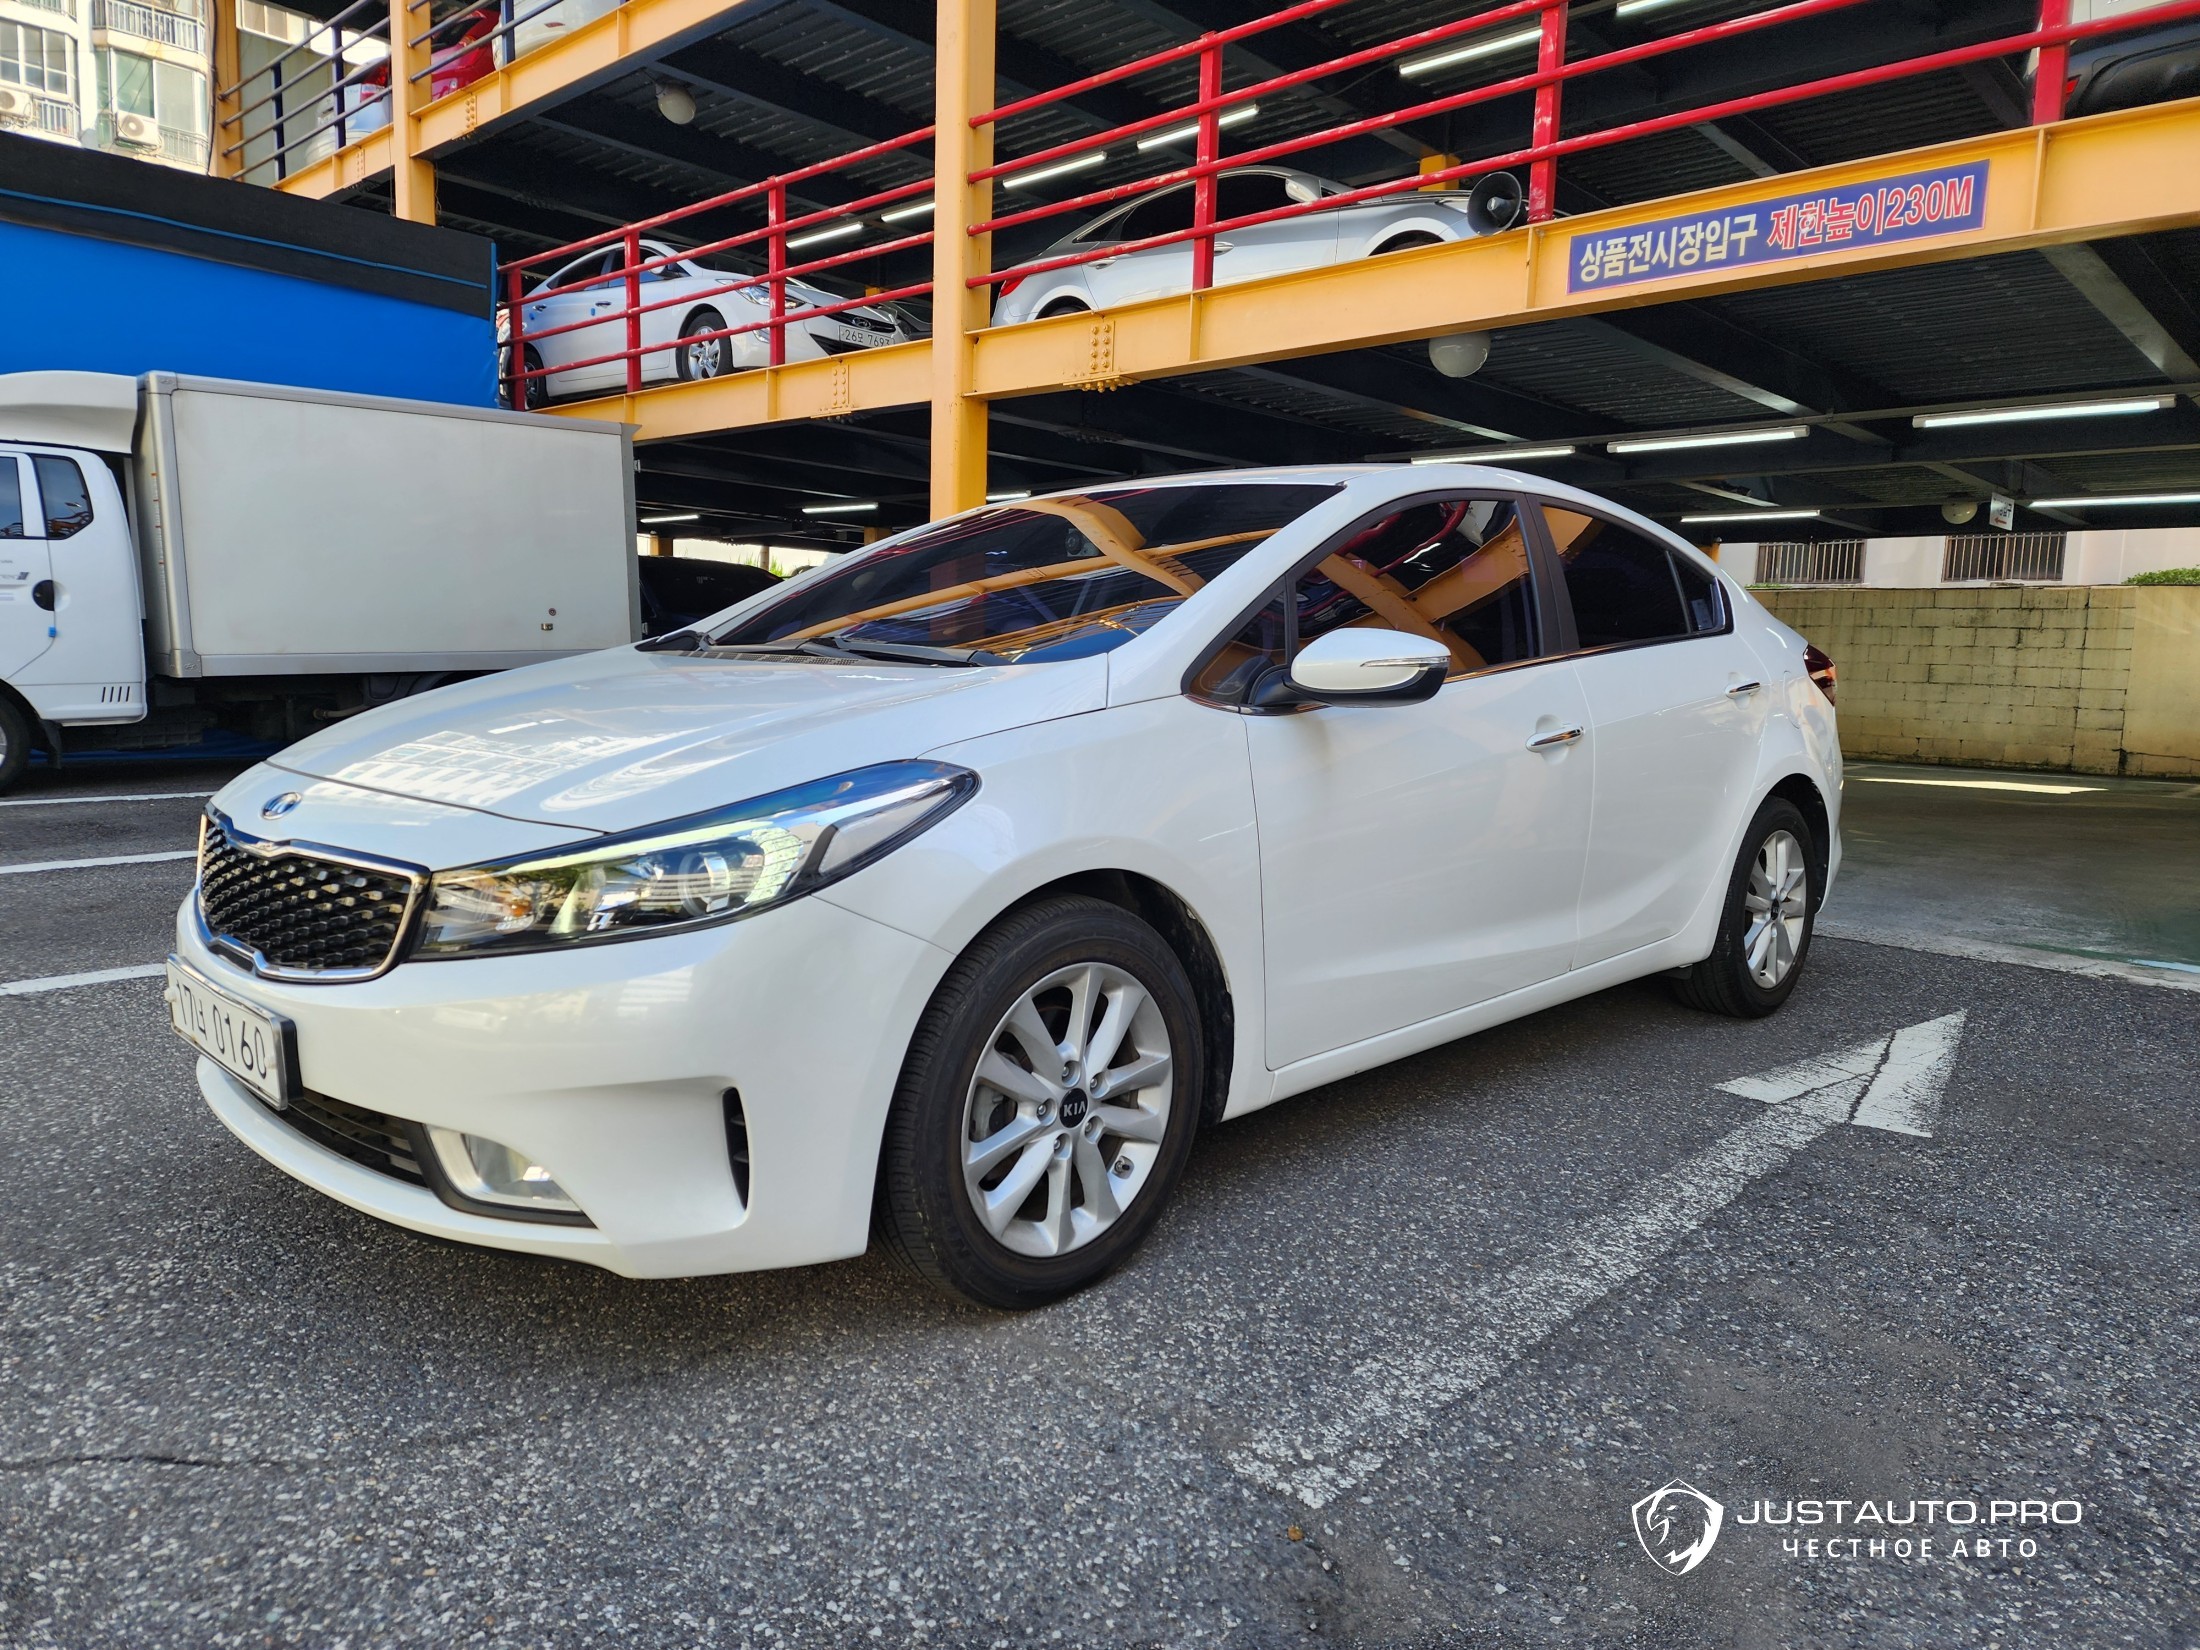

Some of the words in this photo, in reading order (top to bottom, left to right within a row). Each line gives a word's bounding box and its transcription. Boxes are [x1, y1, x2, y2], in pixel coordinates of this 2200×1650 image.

[1580, 213, 1758, 282] 상품전시장입구
[212, 1003, 267, 1080] 0160
[1063, 1100, 1086, 1117] KIA
